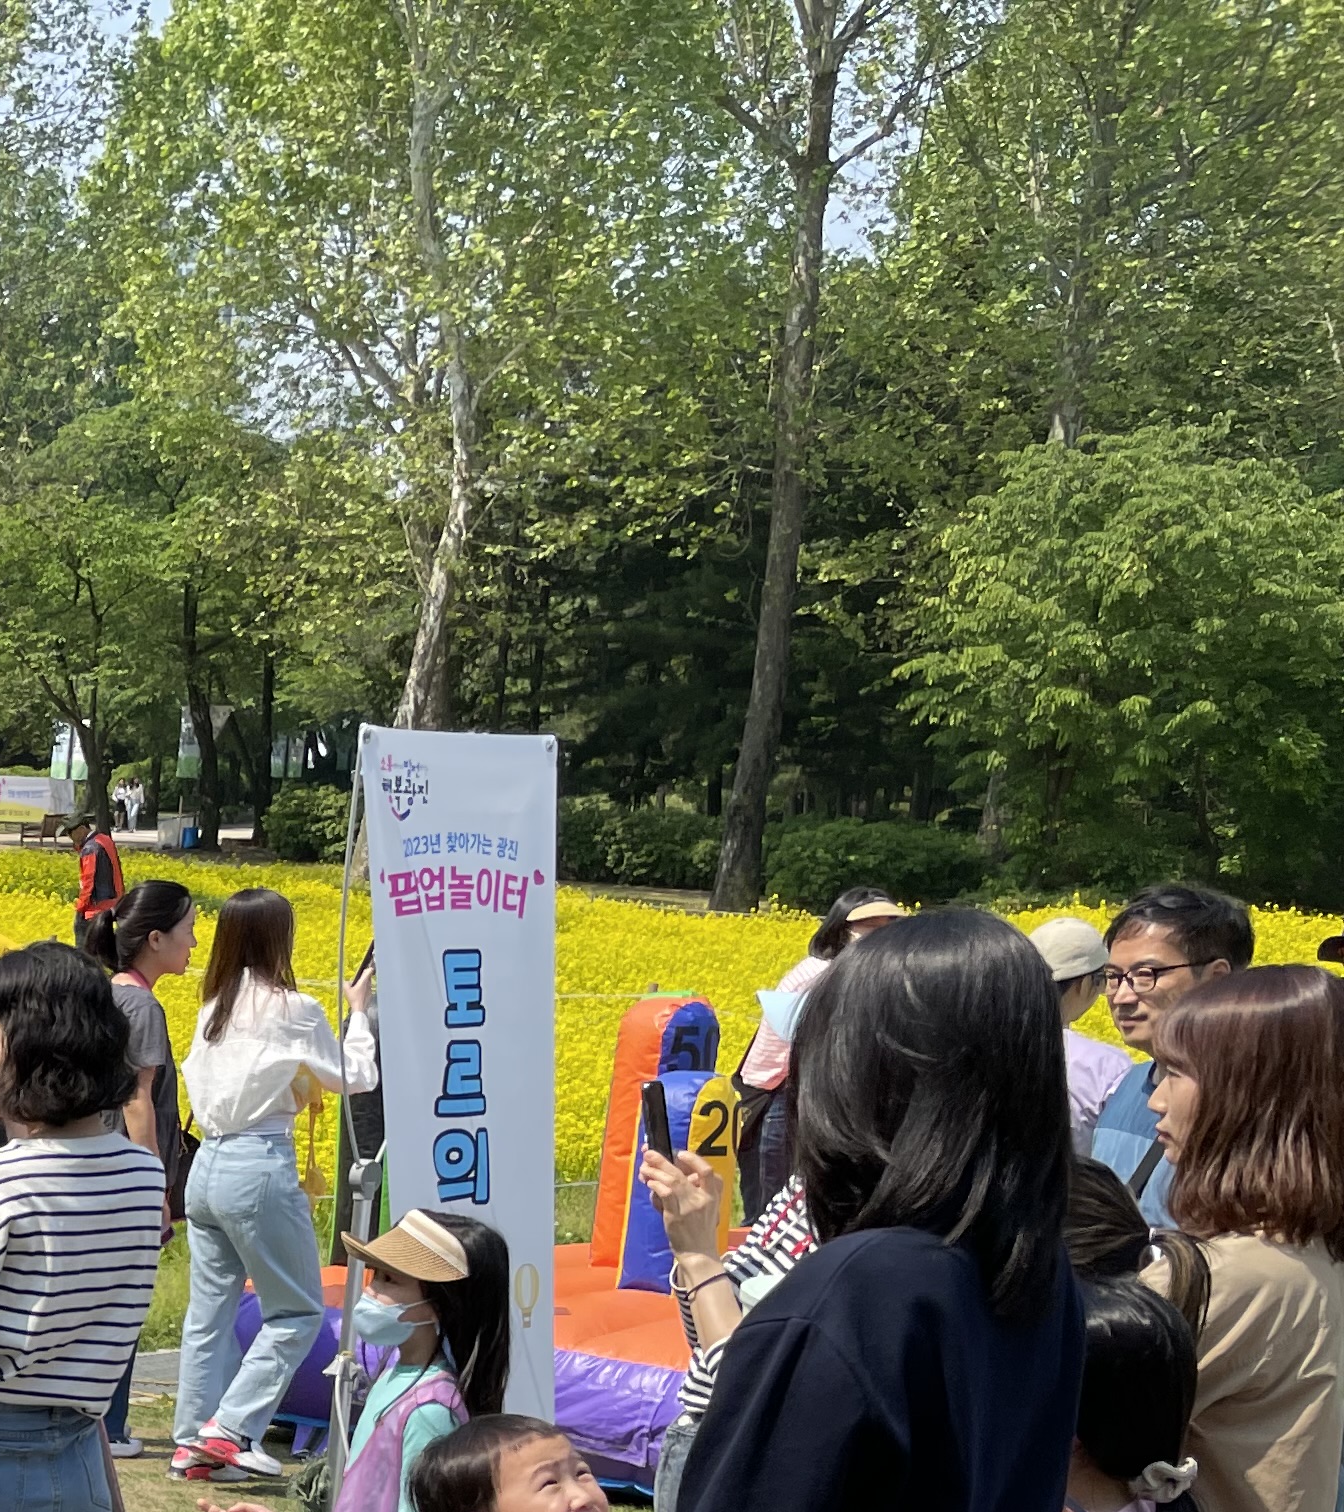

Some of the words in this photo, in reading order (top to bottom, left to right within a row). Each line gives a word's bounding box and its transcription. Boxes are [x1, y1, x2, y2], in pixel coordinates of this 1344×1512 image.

[403, 833, 441, 858] 2023년
[446, 832, 492, 855] 찾아가는
[497, 837, 518, 861] 광진
[433, 948, 490, 1205] 토르의
